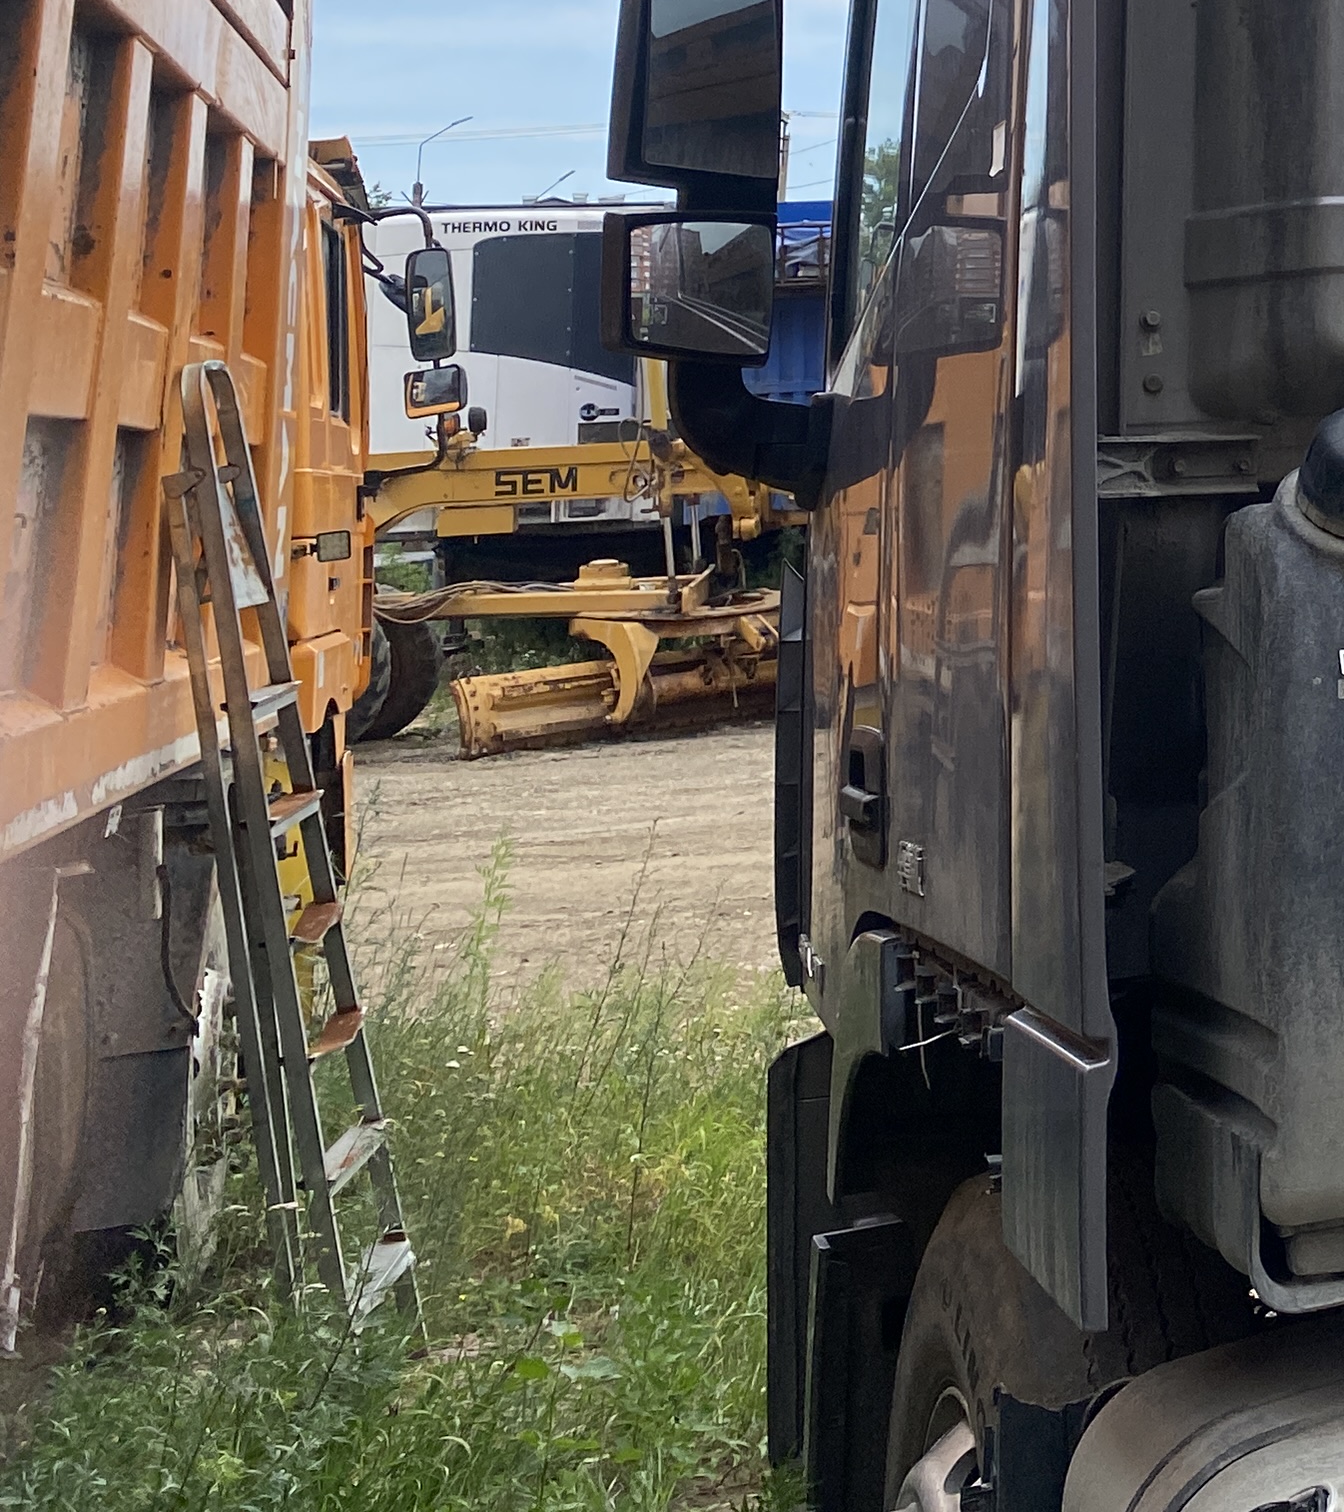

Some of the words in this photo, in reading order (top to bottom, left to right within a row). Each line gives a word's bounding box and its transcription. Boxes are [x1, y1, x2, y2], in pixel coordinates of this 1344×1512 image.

[441, 221, 511, 234] THERMO
[518, 220, 558, 232] KING
[494, 466, 578, 497] SEM
